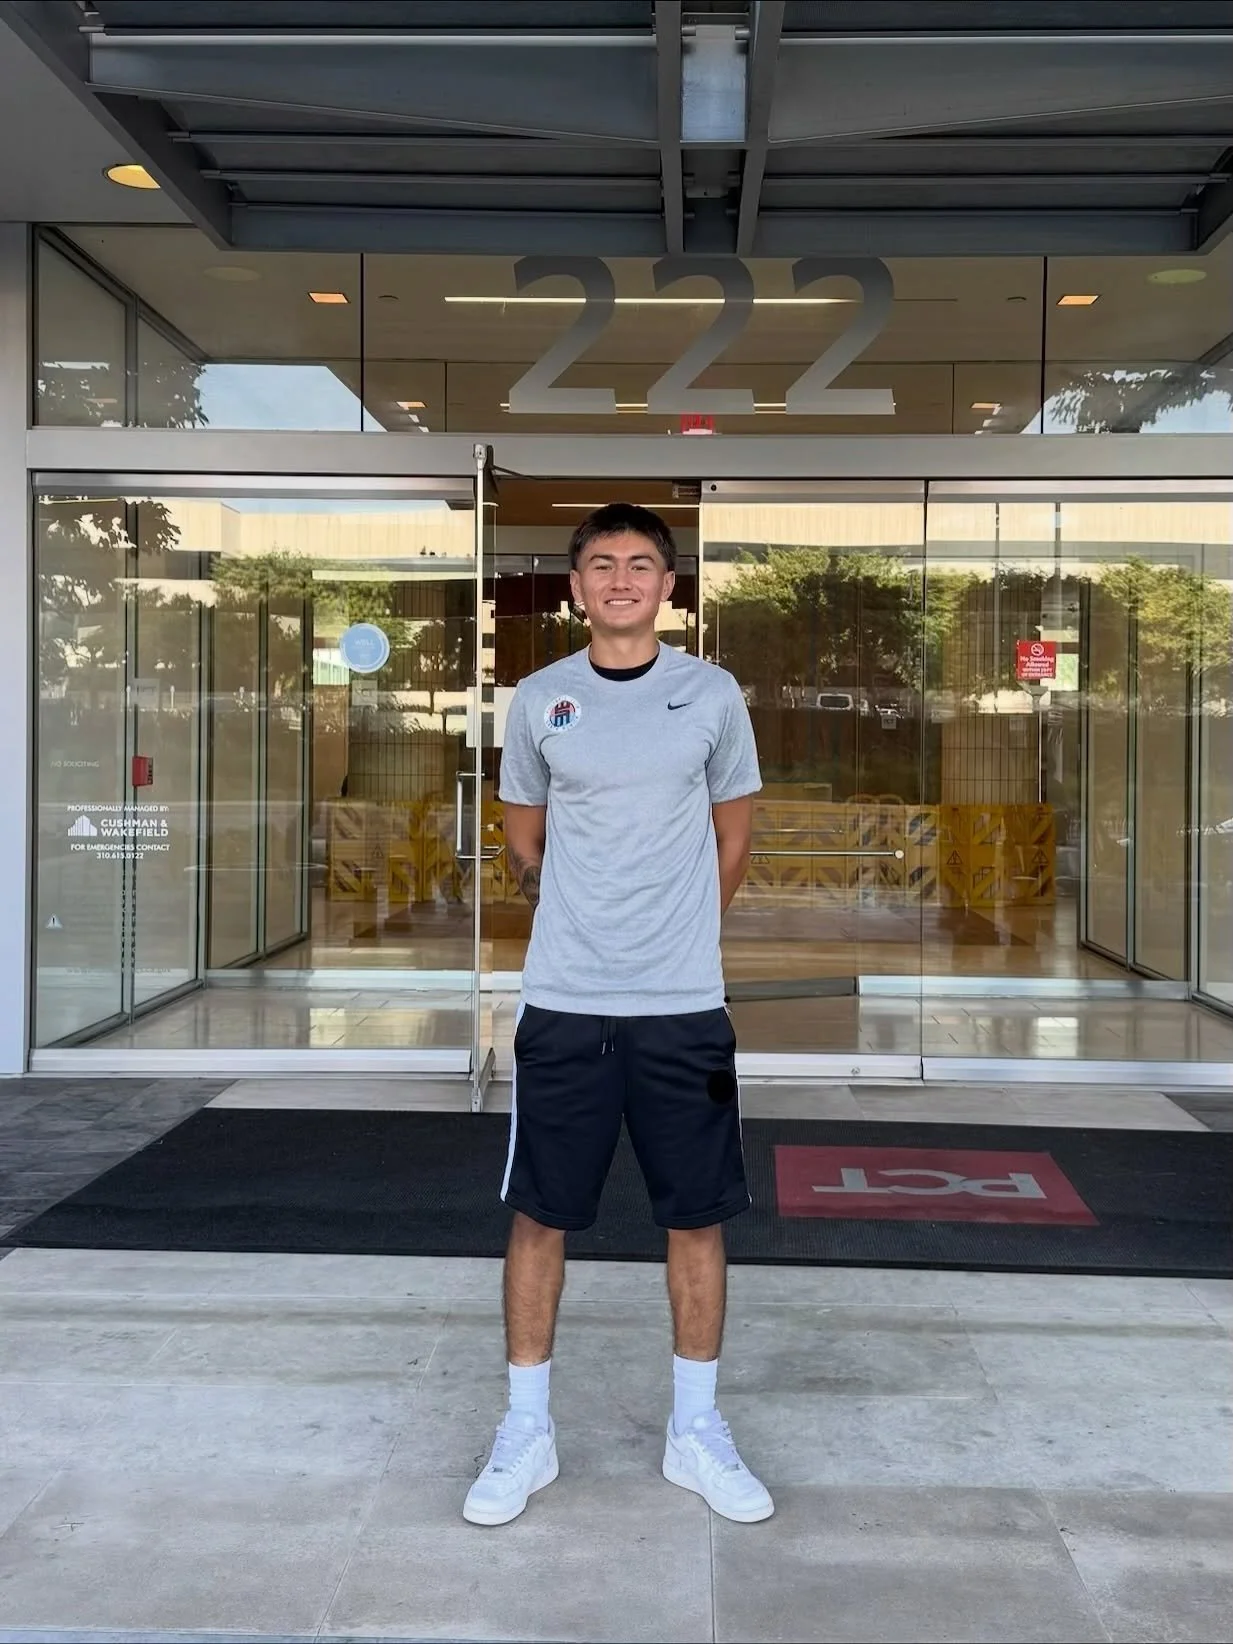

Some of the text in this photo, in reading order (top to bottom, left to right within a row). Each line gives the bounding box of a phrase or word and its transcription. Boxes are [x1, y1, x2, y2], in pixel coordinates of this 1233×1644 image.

[508, 255, 896, 416] 222
[1030, 655, 1055, 663] Smoking
[101, 819, 168, 828] CUSHMAN &
[101, 828, 169, 837] WAKEFIELD
[812, 1168, 1048, 1199] PCT
